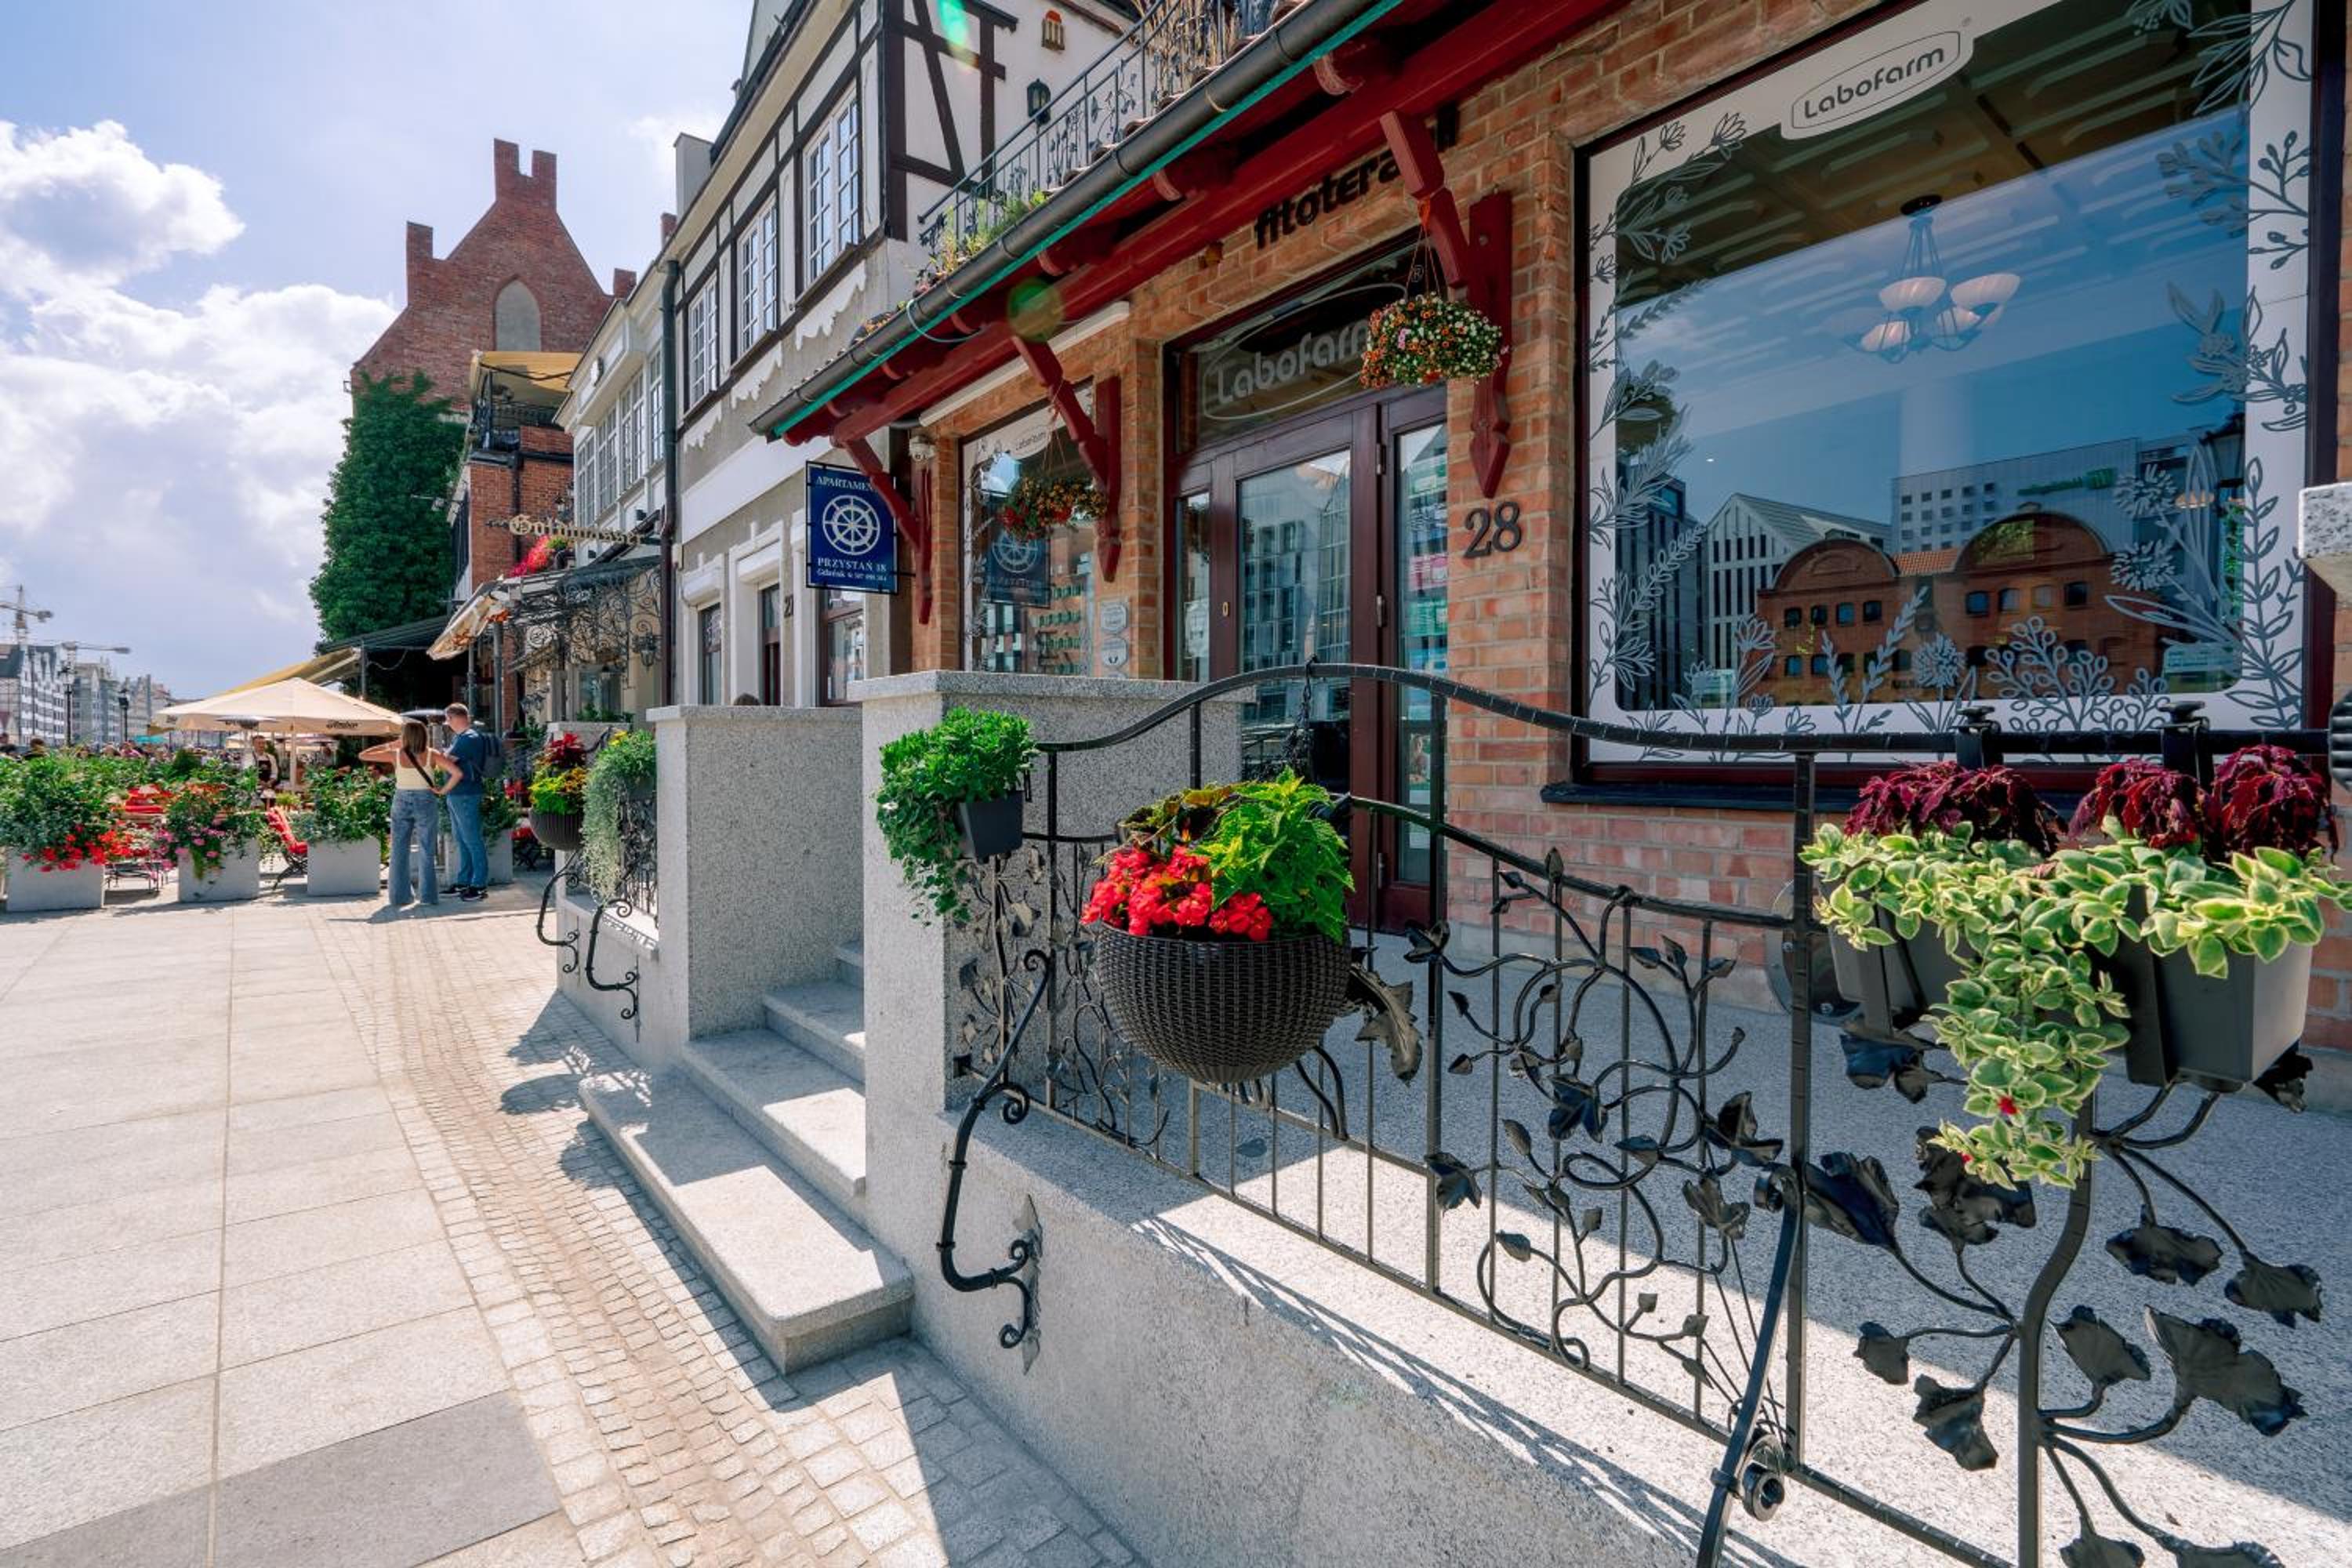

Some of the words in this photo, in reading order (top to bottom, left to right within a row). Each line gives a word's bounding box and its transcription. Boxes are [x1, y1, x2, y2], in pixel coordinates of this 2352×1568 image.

[1804, 47, 1944, 119] Labofarm
[1254, 148, 1402, 250] fitotera
[815, 476, 874, 492] APARTAMEN
[1461, 500, 1523, 559] 28
